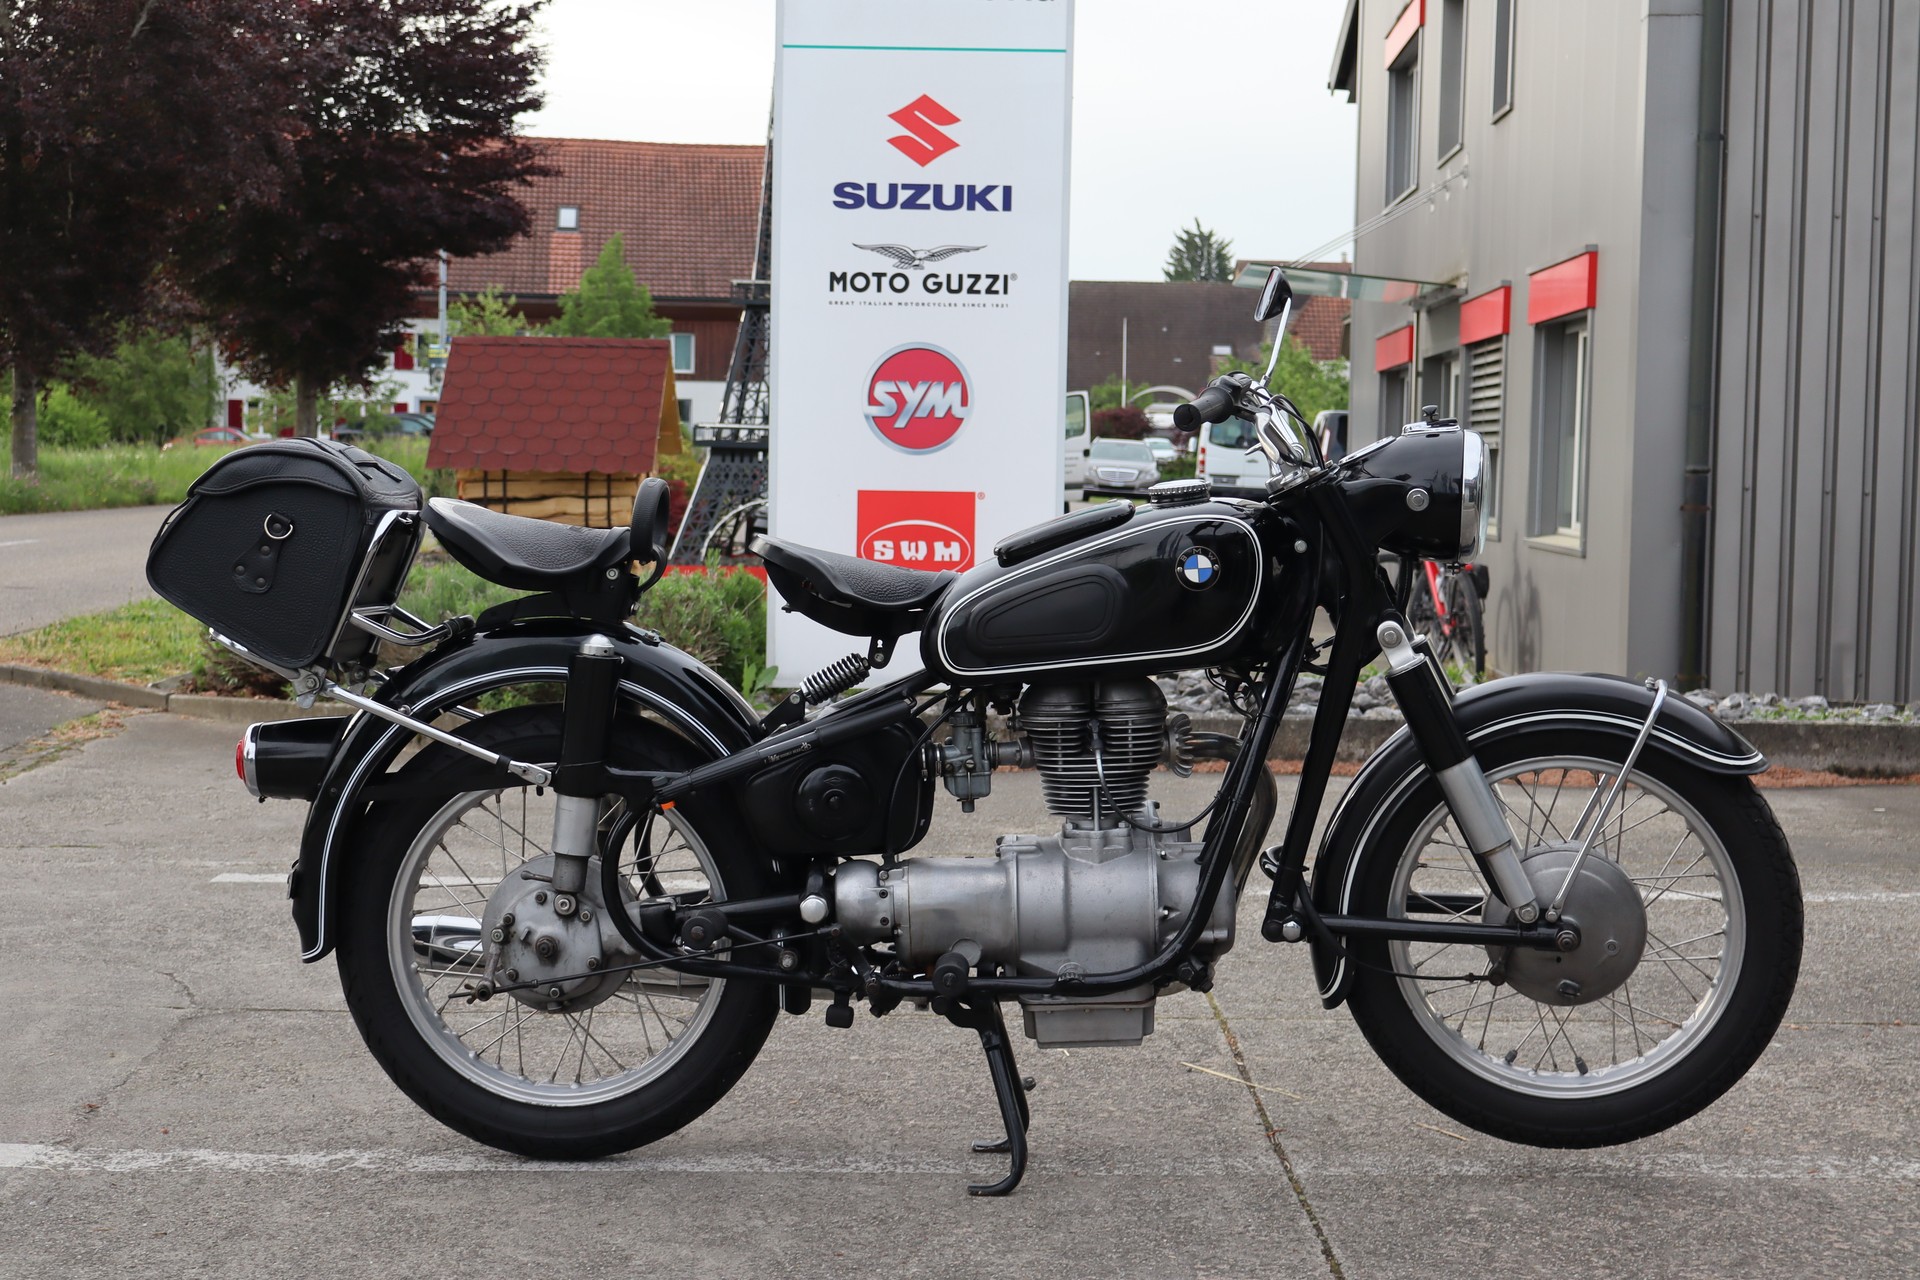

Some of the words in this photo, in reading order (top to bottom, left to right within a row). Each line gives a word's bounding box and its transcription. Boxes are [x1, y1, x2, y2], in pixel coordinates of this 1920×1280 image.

[832, 182, 1012, 211] SUZUKI
[829, 271, 910, 293] MOTO
[864, 380, 969, 428] SYM
[873, 540, 961, 562] SWM
[1180, 548, 1216, 562] BMW
